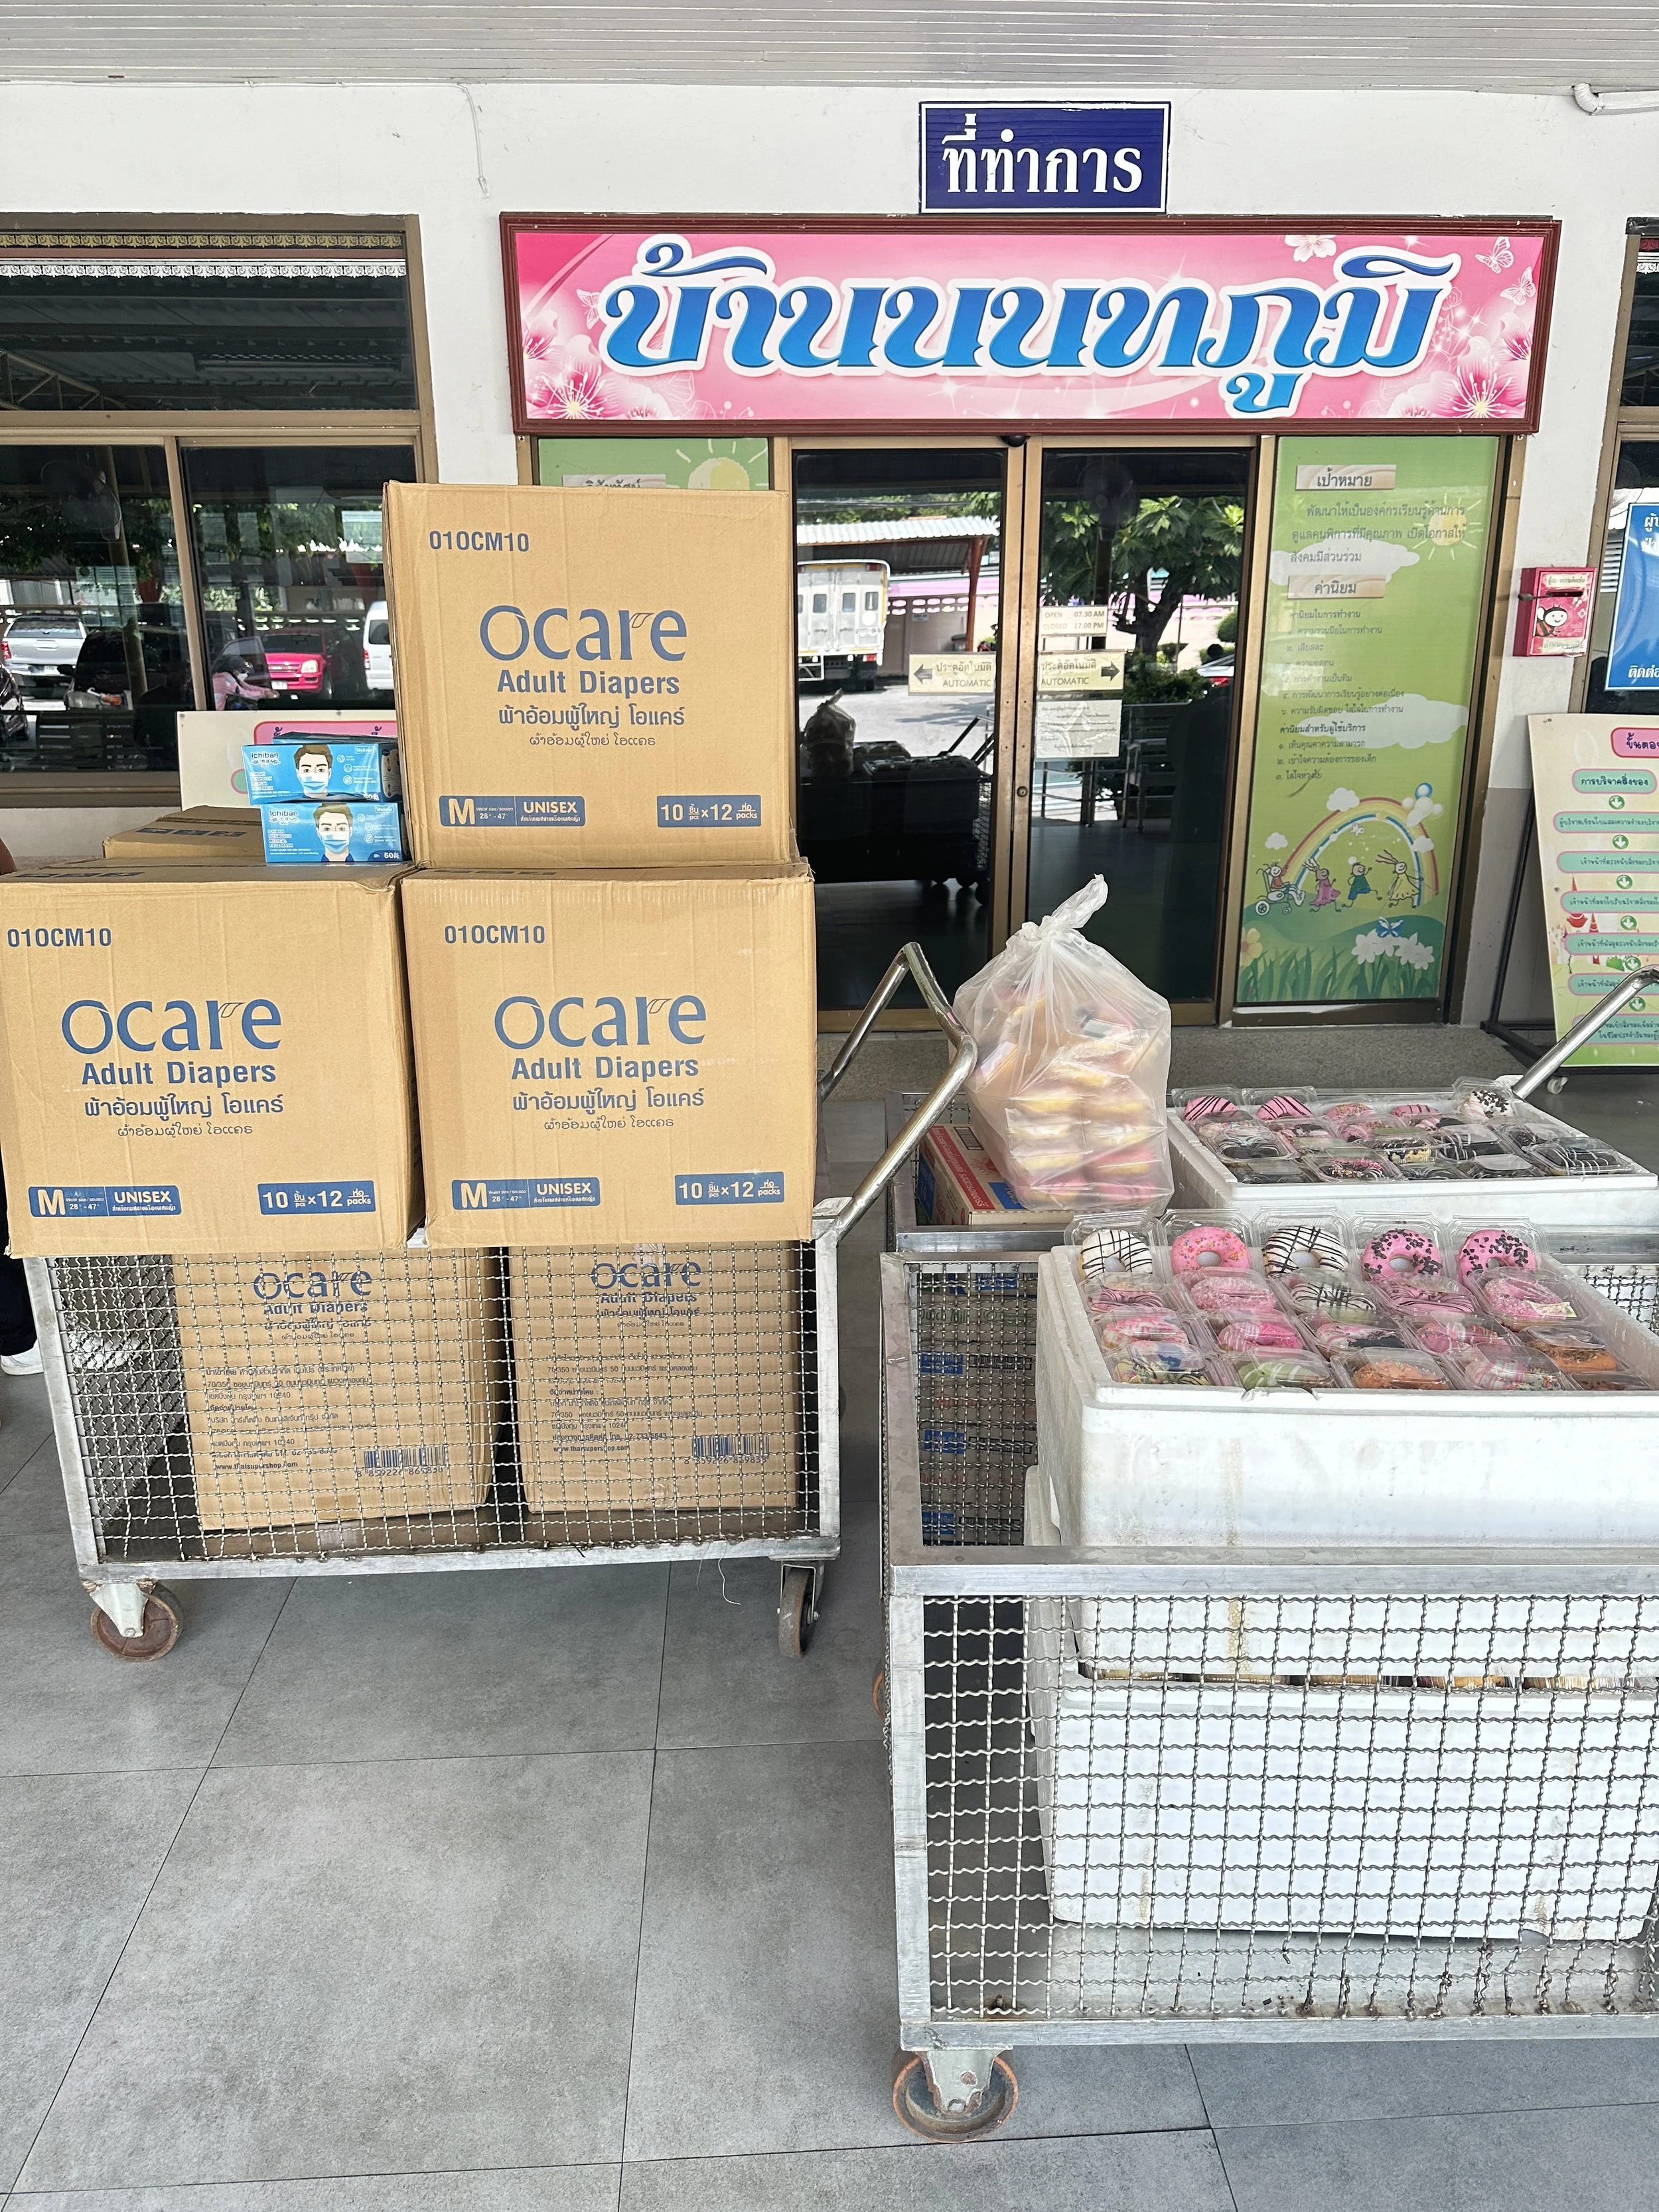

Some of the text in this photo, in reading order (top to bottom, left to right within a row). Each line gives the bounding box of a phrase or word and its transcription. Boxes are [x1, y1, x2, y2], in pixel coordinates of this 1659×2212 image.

[942, 111, 1141, 195] ที่ทำการ
[603, 241, 1457, 414] บ้านนนทภูมิ
[1317, 467, 1372, 488] เป้าหมาย
[1307, 500, 1465, 520] พัฒนาให้เป็นองค์กรเรียนรู้ด้านการ
[1291, 523, 1467, 544] ดูแลคนพิการที่มีคุณภาพ เปิดโอกาสให้
[1290, 548, 1362, 563] สังคมมีส่วนร่วม
[1315, 581, 1356, 594] ค่านิยม
[936, 659, 992, 676] ประตูอัตโนมัติ
[497, 669, 680, 699] Adult Diapers
[942, 679, 991, 688] AUTOMATIC
[1041, 677, 1090, 686] AUTOMATIC
[498, 703, 685, 731] ผ้าอ้อมผู้ใหญ่ โอแคร์
[1581, 773, 1649, 786] การบริจาคสิ่งของ
[448, 798, 476, 825] M
[524, 801, 577, 814] UNISEX
[661, 804, 683, 821] 10
[711, 804, 733, 820] 12
[736, 811, 758, 820] packs
[82, 1061, 276, 1088] Adult Diapers
[512, 1056, 699, 1082] Adult Diapers
[85, 1093, 283, 1121] ผ้าอ้อมผู้ใหญ่ โอแคร์
[513, 1087, 705, 1116] ผ้าอ้อมผู้ใหญ่ โอแคร์
[114, 1191, 172, 1203] UNISEX
[352, 1188, 364, 1197] ห่อ
[461, 1182, 488, 1209] M
[536, 1182, 592, 1195] UNISEX
[679, 1182, 703, 1199] 10
[730, 1181, 754, 1198] 12
[758, 1187, 781, 1197] packs
[37, 1189, 66, 1216] M
[263, 1193, 288, 1209] 10
[317, 1191, 342, 1207] 12
[346, 1196, 372, 1207] packs
[601, 1291, 697, 1305] Adult Diapers
[263, 1301, 368, 1315] Adult Diapers
